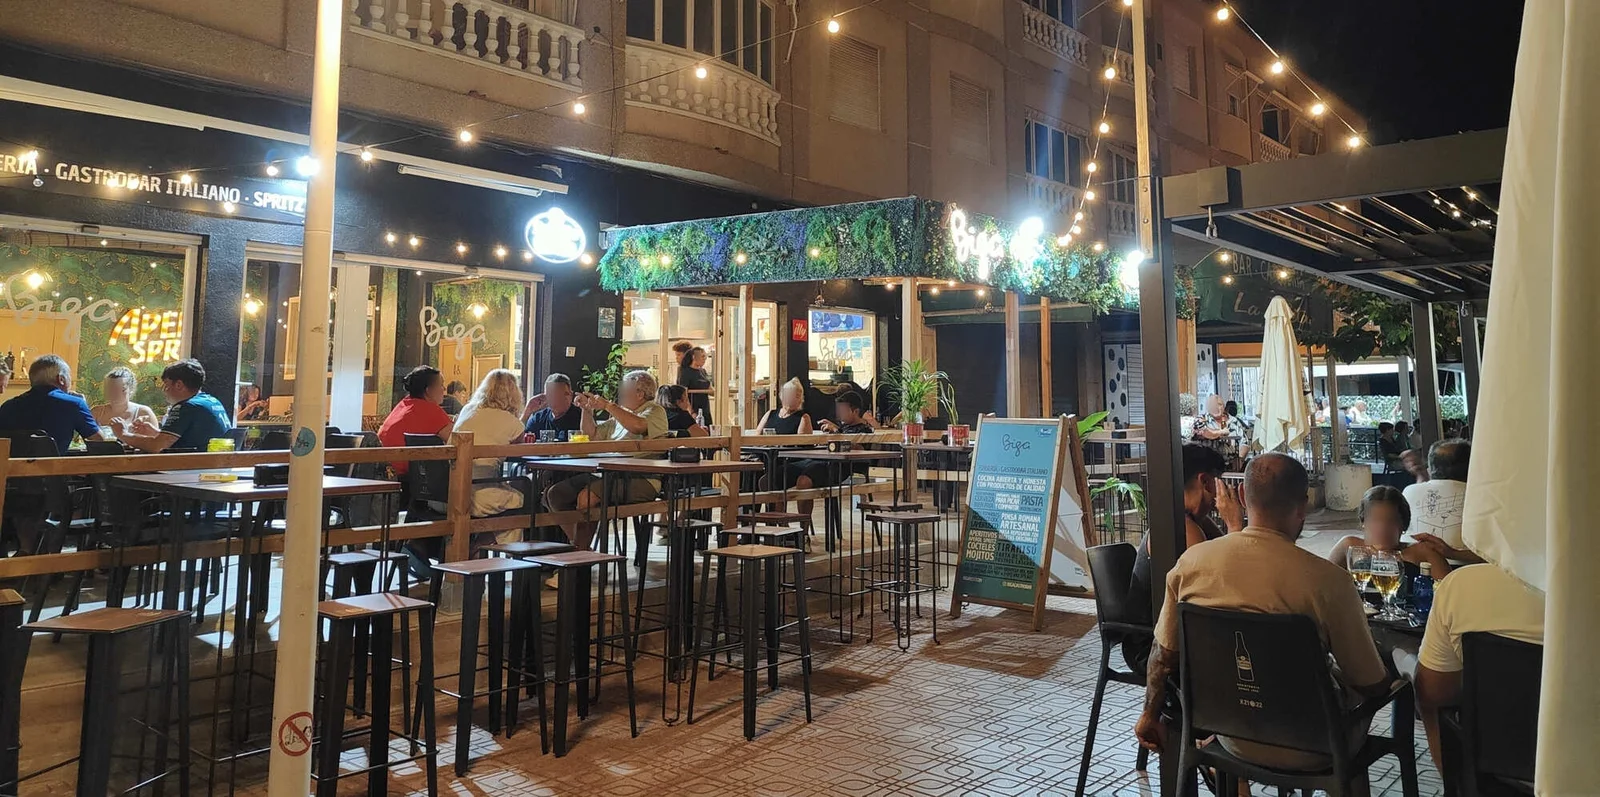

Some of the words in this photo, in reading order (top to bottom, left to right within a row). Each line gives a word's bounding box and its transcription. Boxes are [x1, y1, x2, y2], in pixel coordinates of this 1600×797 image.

[166, 178, 241, 204] ITALIANO
[253, 191, 306, 213] SPRITZ
[1232, 252, 1253, 277] BAR
[419, 306, 488, 361] Biga
[793, 323, 807, 339] illy
[1002, 433, 1031, 457] Biga
[977, 474, 995, 482] COCINA
[996, 475, 1017, 484] ABIERTA
[1023, 477, 1047, 485] HONESTA
[987, 481, 1015, 490] PRODUCTOS
[1023, 484, 1046, 492] CALIDAD
[1021, 494, 1044, 507] PASTA
[1018, 514, 1041, 523] ROMANA
[1000, 520, 1040, 532] ARTESANAL
[965, 549, 995, 561] MOJITOS
